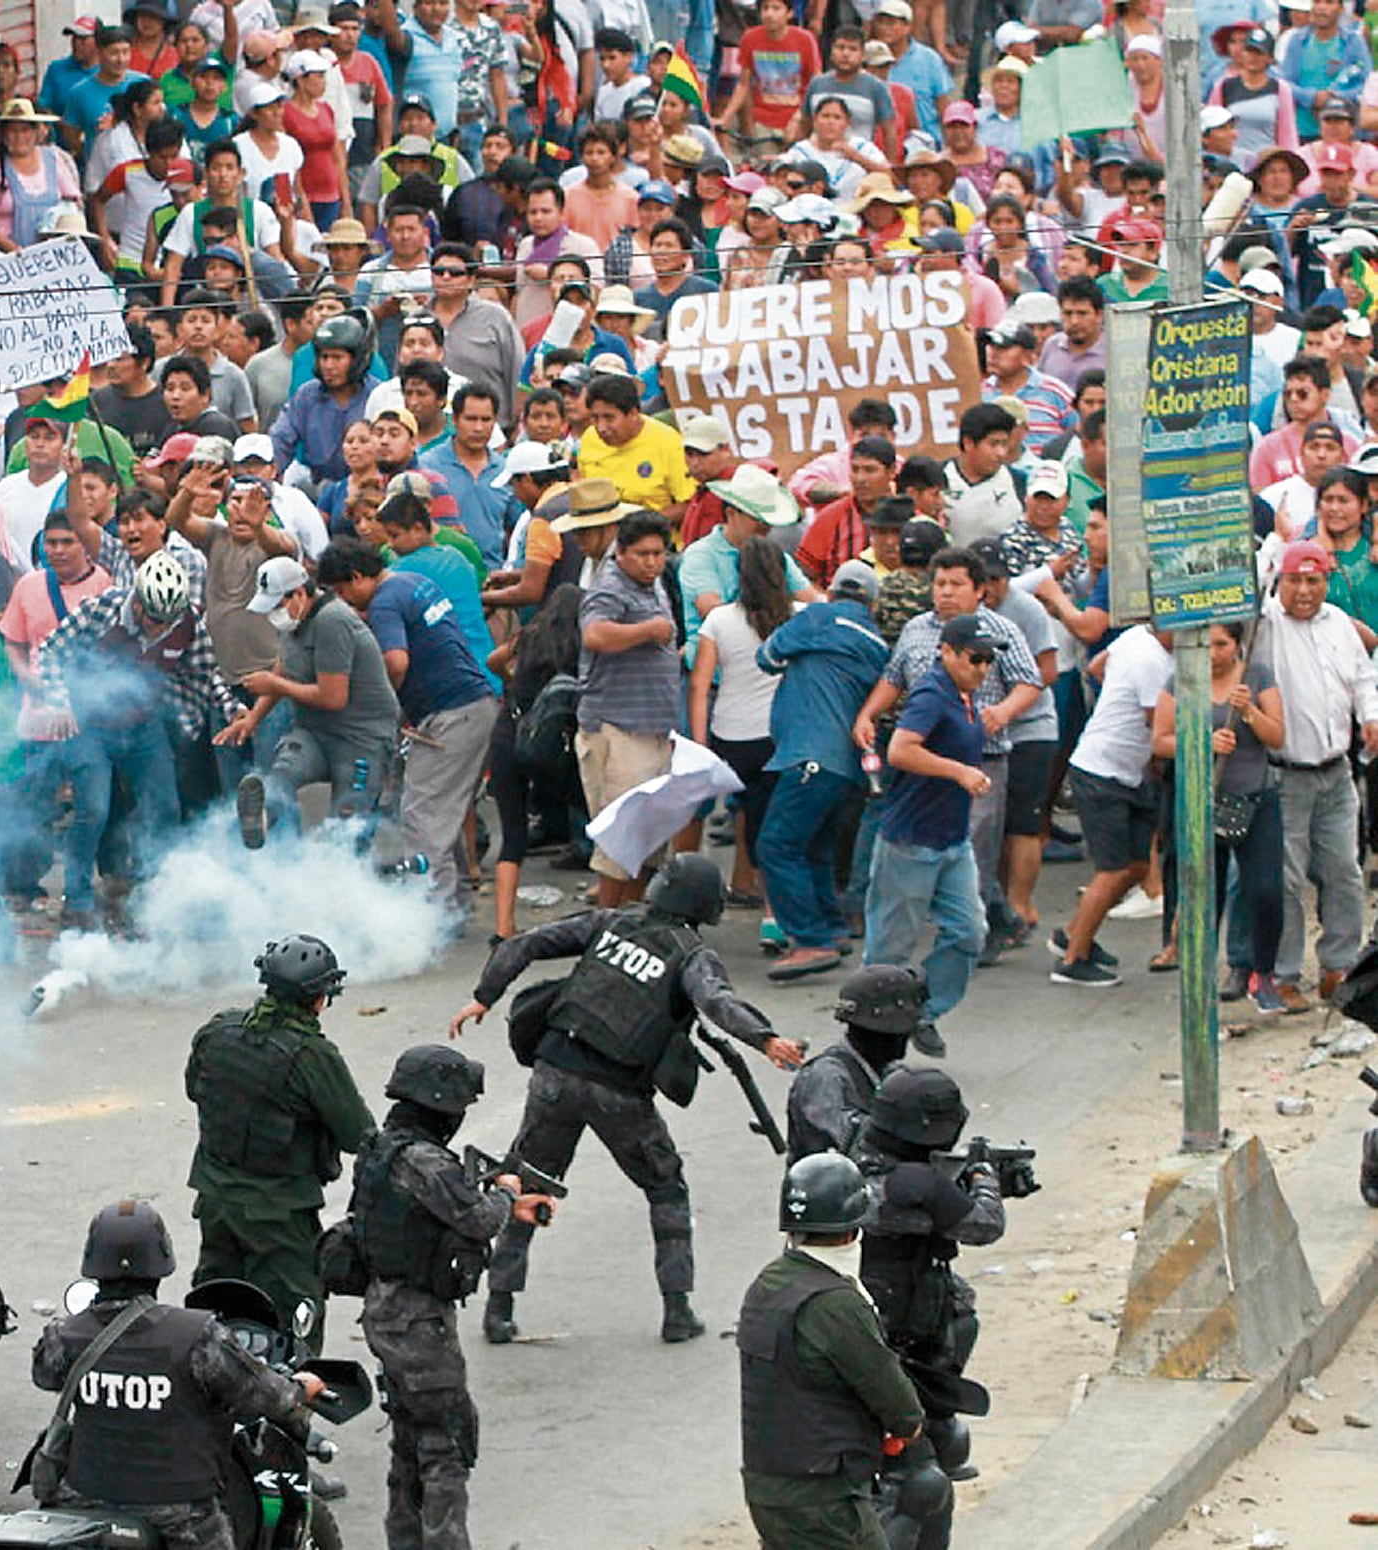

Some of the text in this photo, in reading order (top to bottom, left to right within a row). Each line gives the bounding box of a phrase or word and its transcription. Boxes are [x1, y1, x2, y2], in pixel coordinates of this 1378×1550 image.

[22, 319, 44, 341] AL
[45, 302, 88, 332] PARO
[71, 330, 83, 344] A
[89, 320, 110, 342] LA
[1156, 313, 1248, 349] Orquesta
[663, 327, 956, 401] TRABAJAR
[887, 388, 961, 447] DE
[1143, 378, 1248, 418] Adoración
[595, 930, 666, 983] UTOP
[79, 1371, 172, 1410] UTOP
